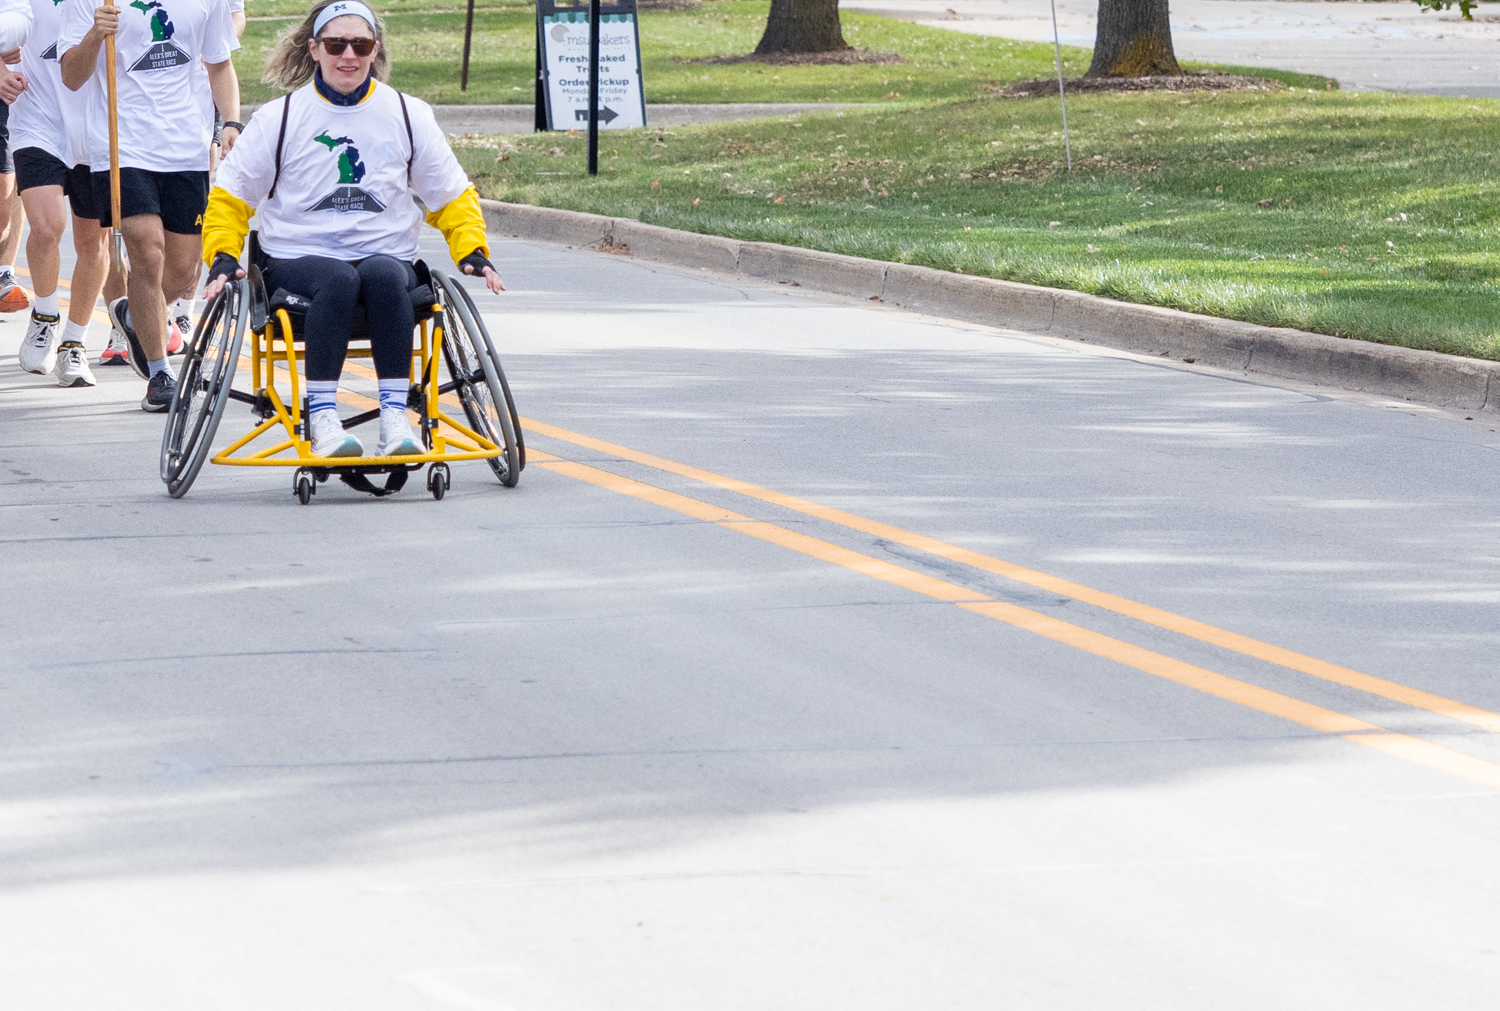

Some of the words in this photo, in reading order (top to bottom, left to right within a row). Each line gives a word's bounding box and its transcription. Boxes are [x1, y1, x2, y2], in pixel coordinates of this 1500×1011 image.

[601, 34, 630, 46] akers
[558, 55, 588, 63] Fresh
[600, 54, 626, 63] aked
[576, 65, 610, 73] Trts
[600, 78, 630, 88] ickup
